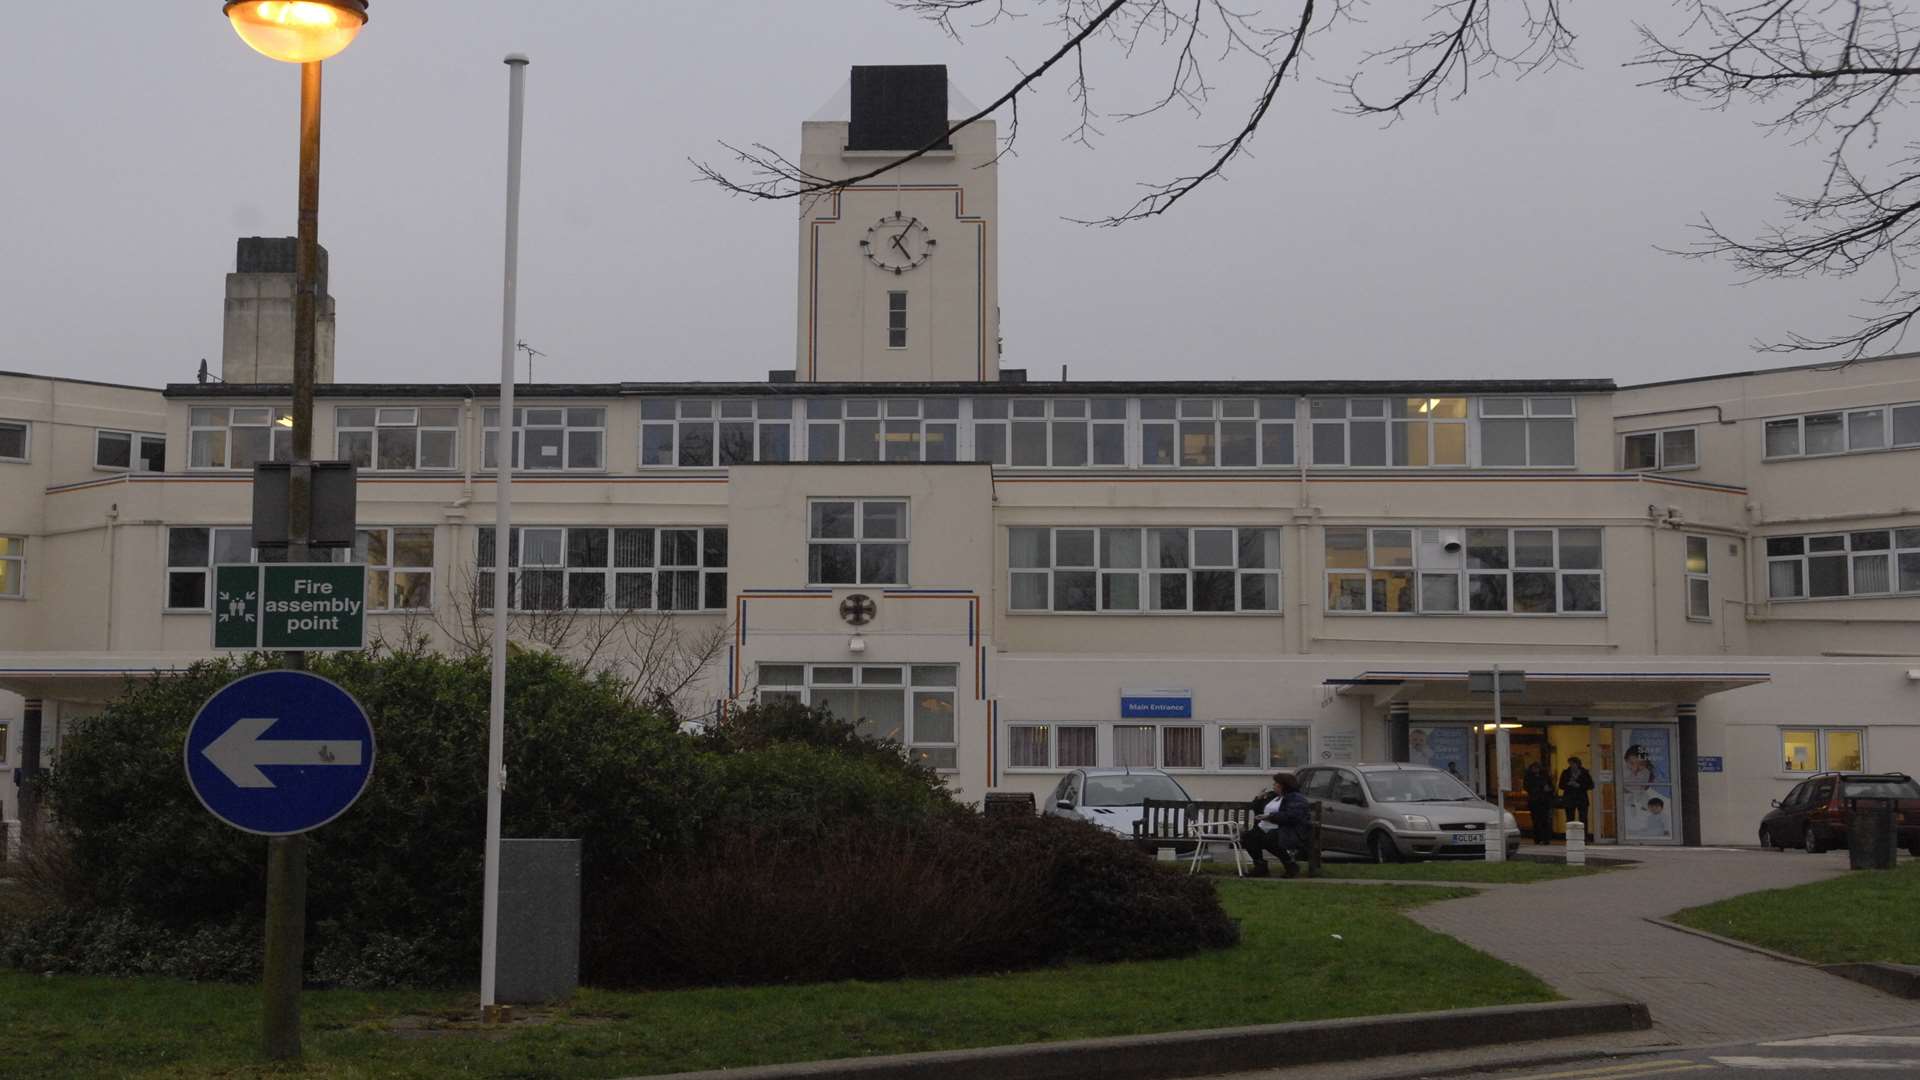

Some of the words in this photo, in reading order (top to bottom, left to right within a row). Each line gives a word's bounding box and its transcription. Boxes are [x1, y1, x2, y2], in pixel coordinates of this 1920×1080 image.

[294, 579, 333, 594] Fire
[265, 597, 361, 616] assembly
[287, 616, 339, 634] point
[1129, 703, 1148, 711] Main
[1150, 703, 1184, 711] Entrance
